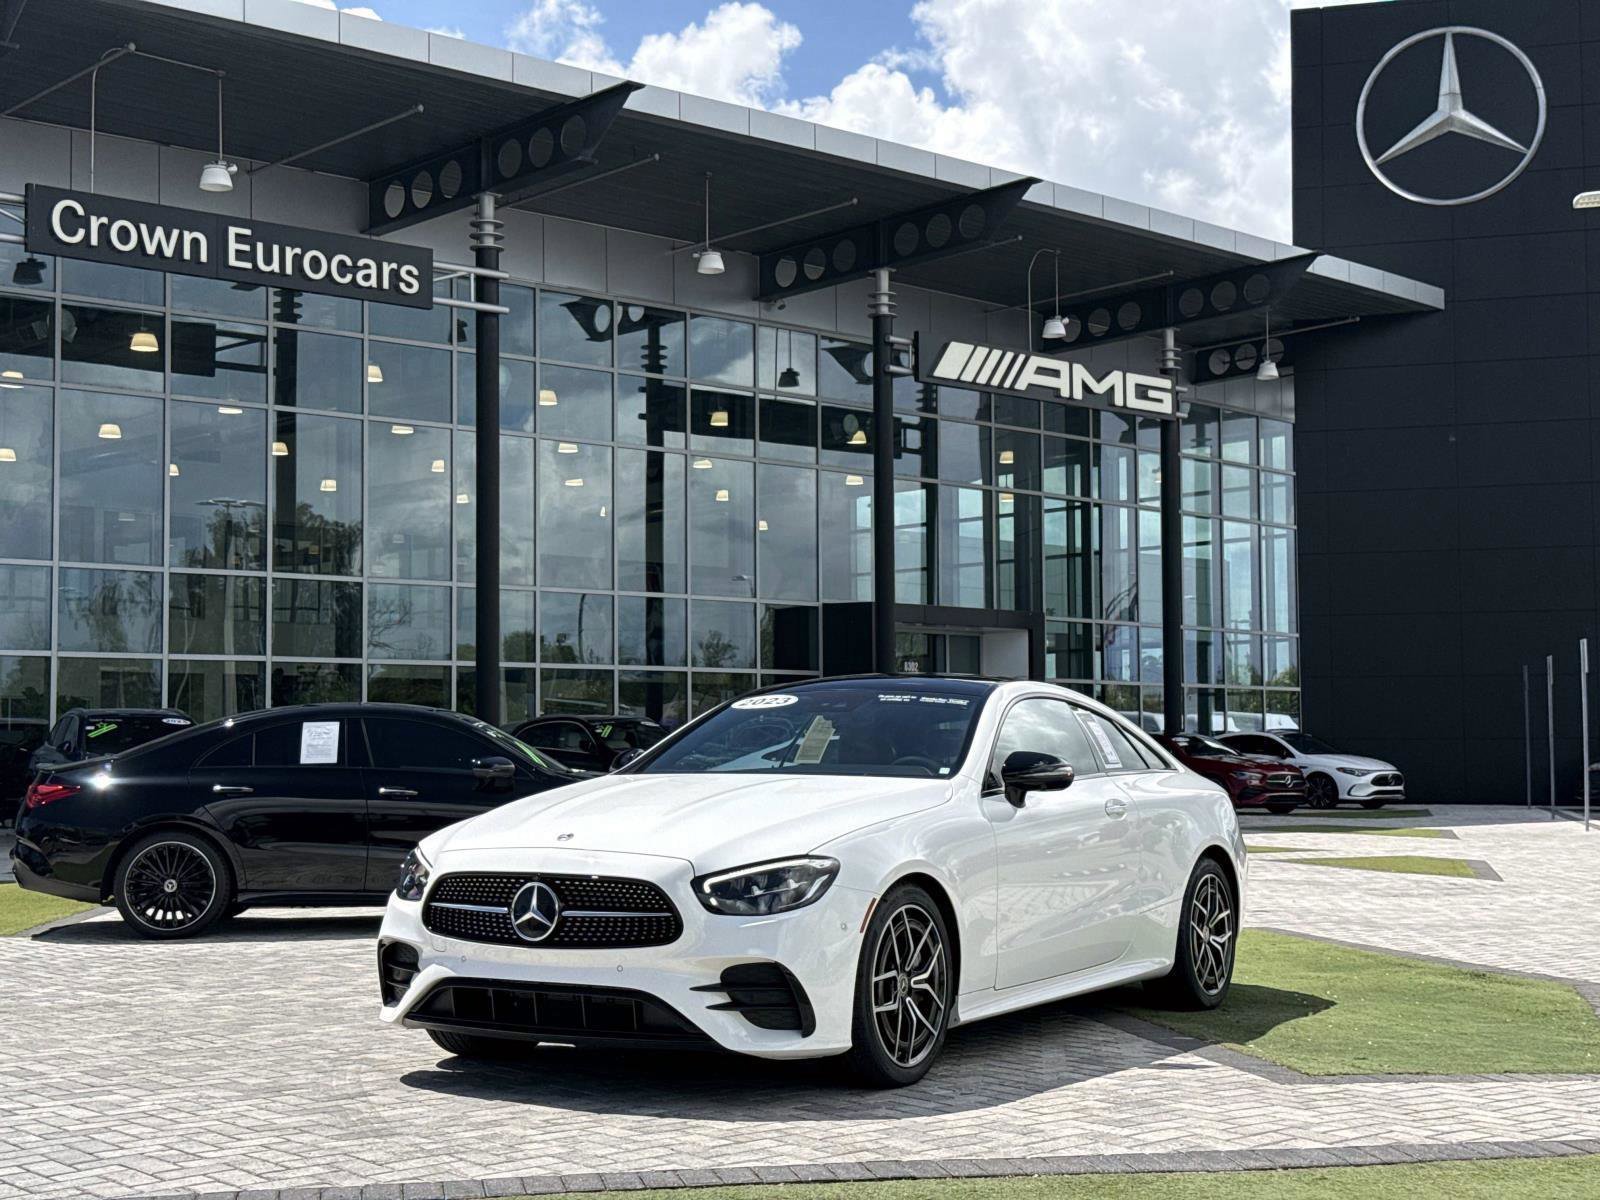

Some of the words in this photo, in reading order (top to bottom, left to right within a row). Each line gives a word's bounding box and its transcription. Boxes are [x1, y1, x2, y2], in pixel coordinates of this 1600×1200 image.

[51, 199, 208, 263] Crown
[227, 225, 421, 295] Eurocars
[1014, 355, 1173, 414] AMG
[737, 697, 793, 707] 2023
